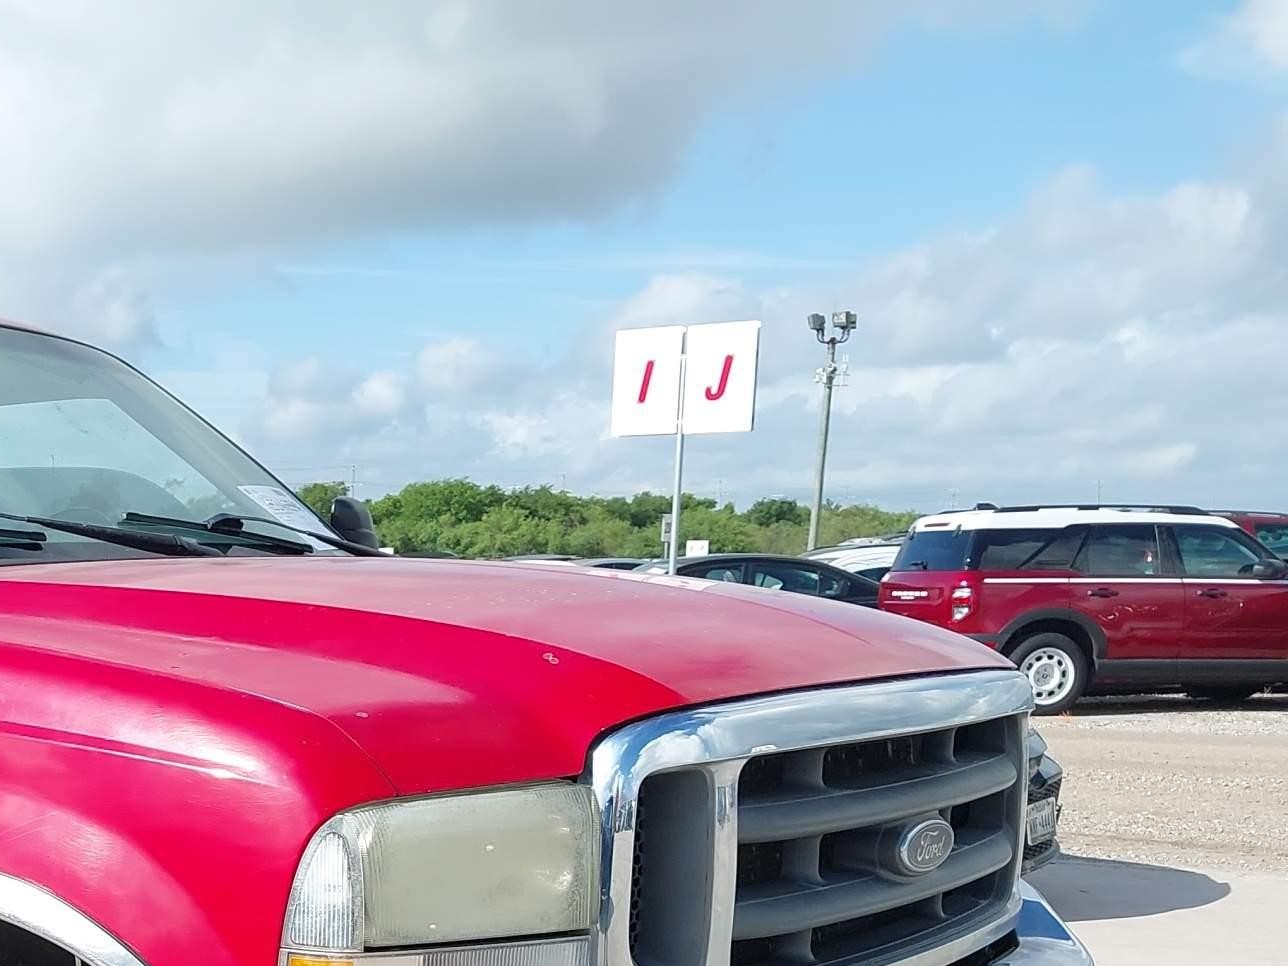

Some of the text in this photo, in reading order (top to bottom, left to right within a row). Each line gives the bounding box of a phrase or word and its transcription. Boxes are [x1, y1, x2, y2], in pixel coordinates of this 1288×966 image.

[637, 354, 734, 403] I J
[917, 830, 945, 861] Ford
